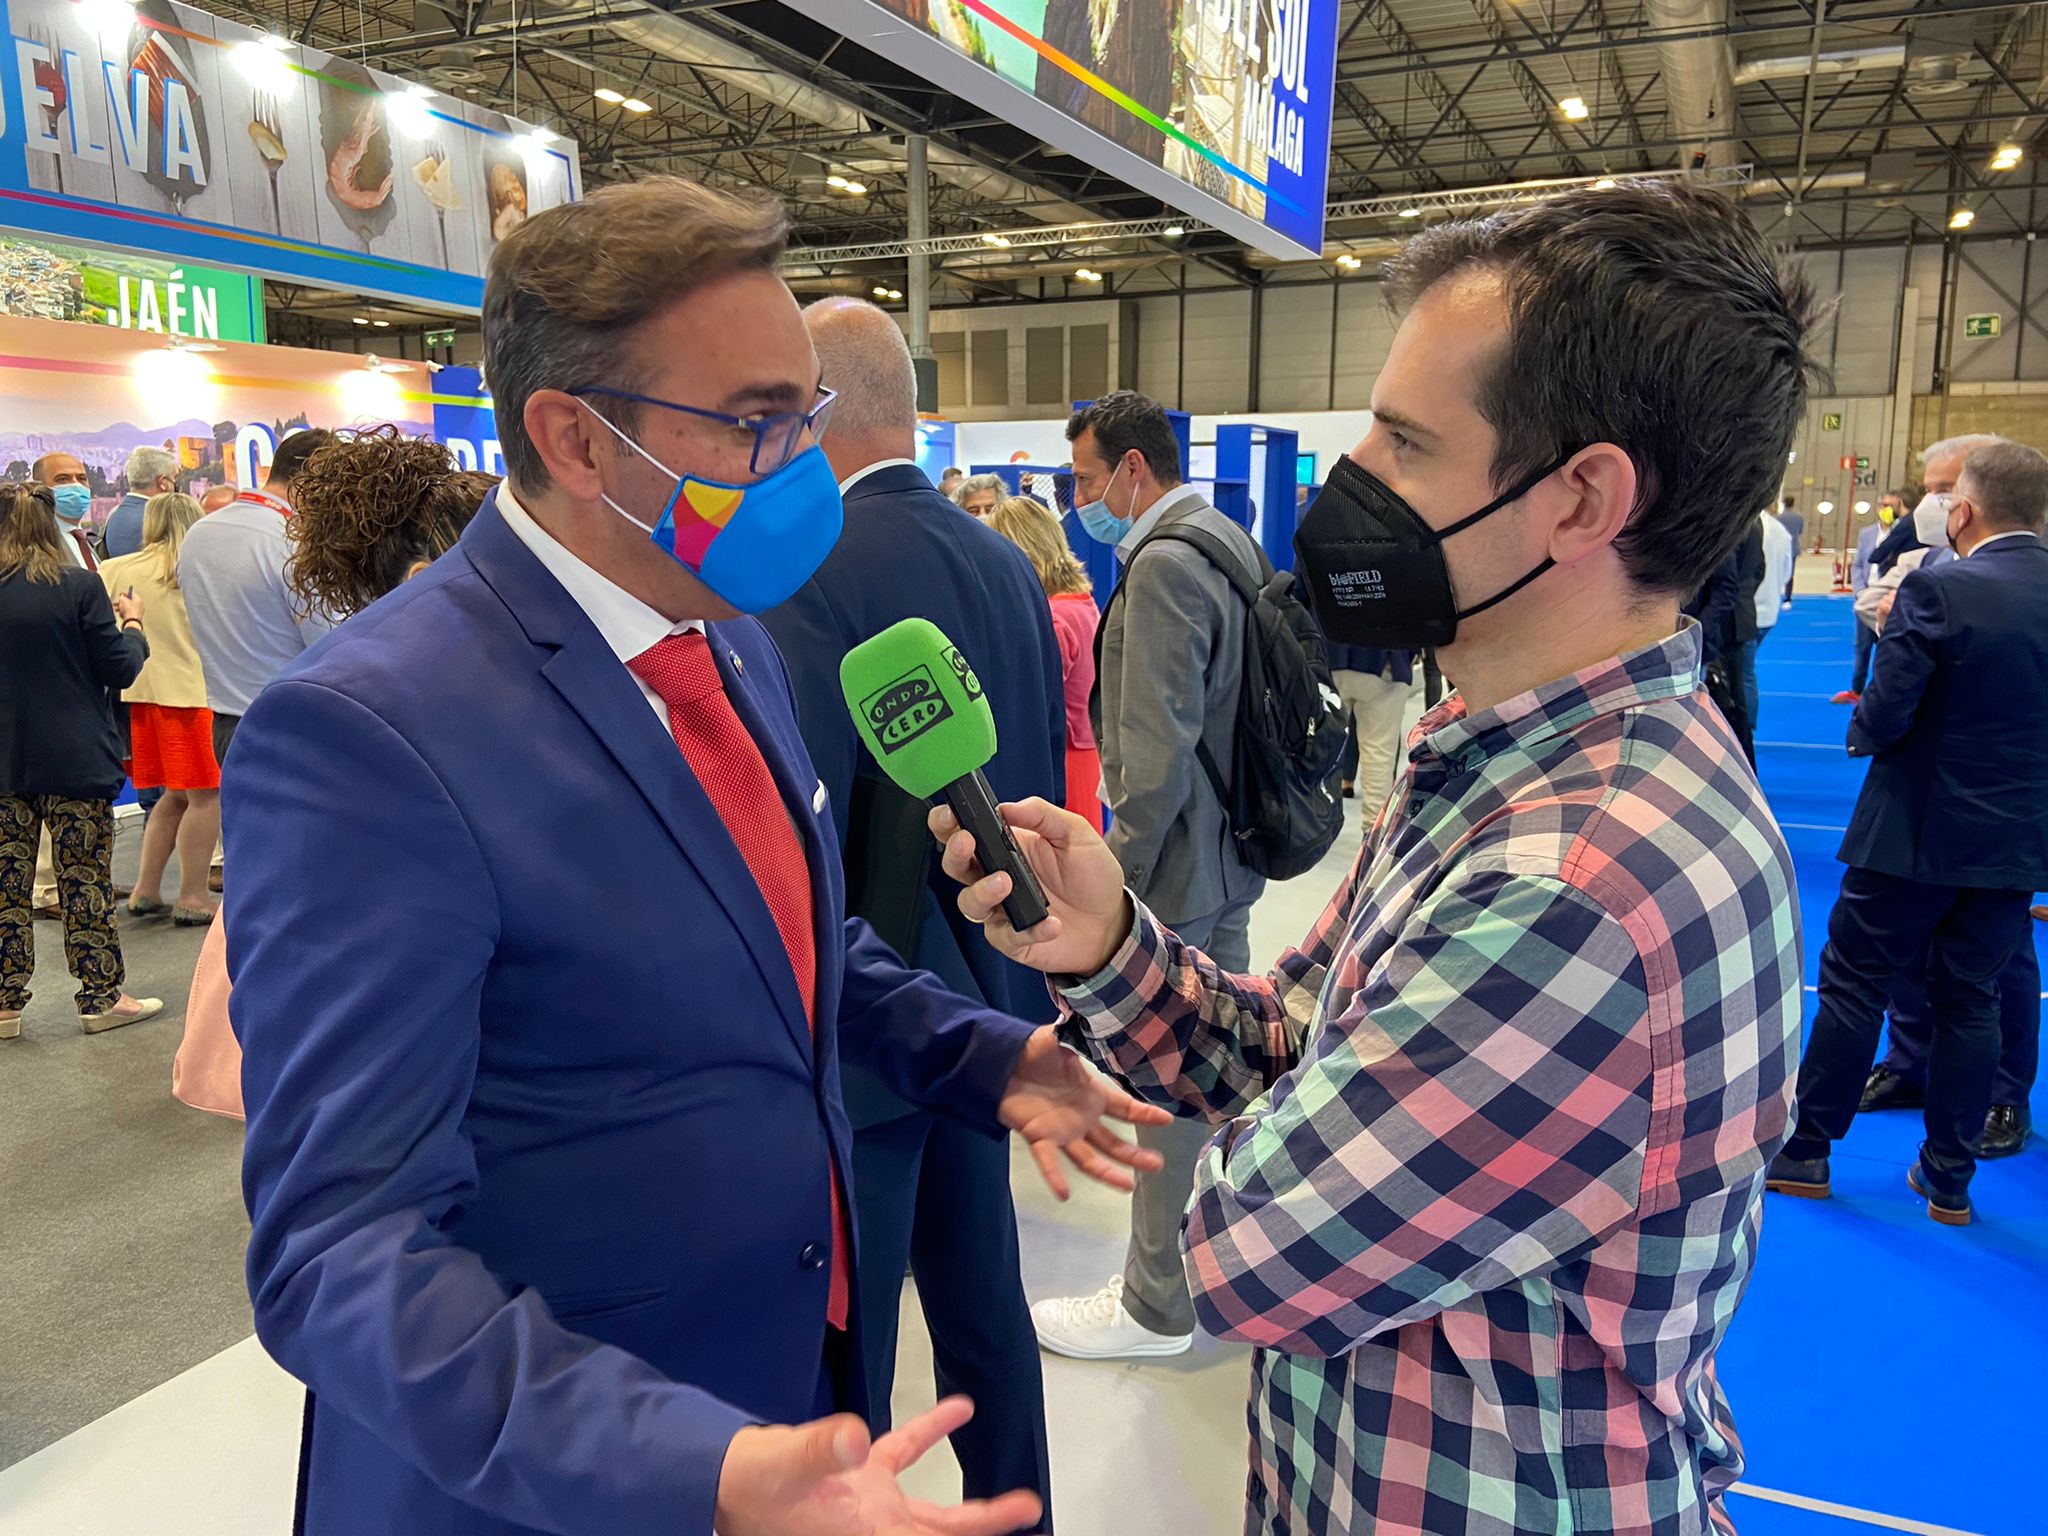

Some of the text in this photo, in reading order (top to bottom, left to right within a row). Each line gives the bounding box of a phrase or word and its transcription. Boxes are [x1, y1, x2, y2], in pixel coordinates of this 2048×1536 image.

[1267, 0, 1309, 104] SOL
[0, 36, 207, 186] ELVA
[1241, 73, 1304, 177] MÁLAGA
[107, 269, 219, 340] JAÉN
[875, 684, 924, 718] ONDA
[888, 702, 937, 739] CERO
